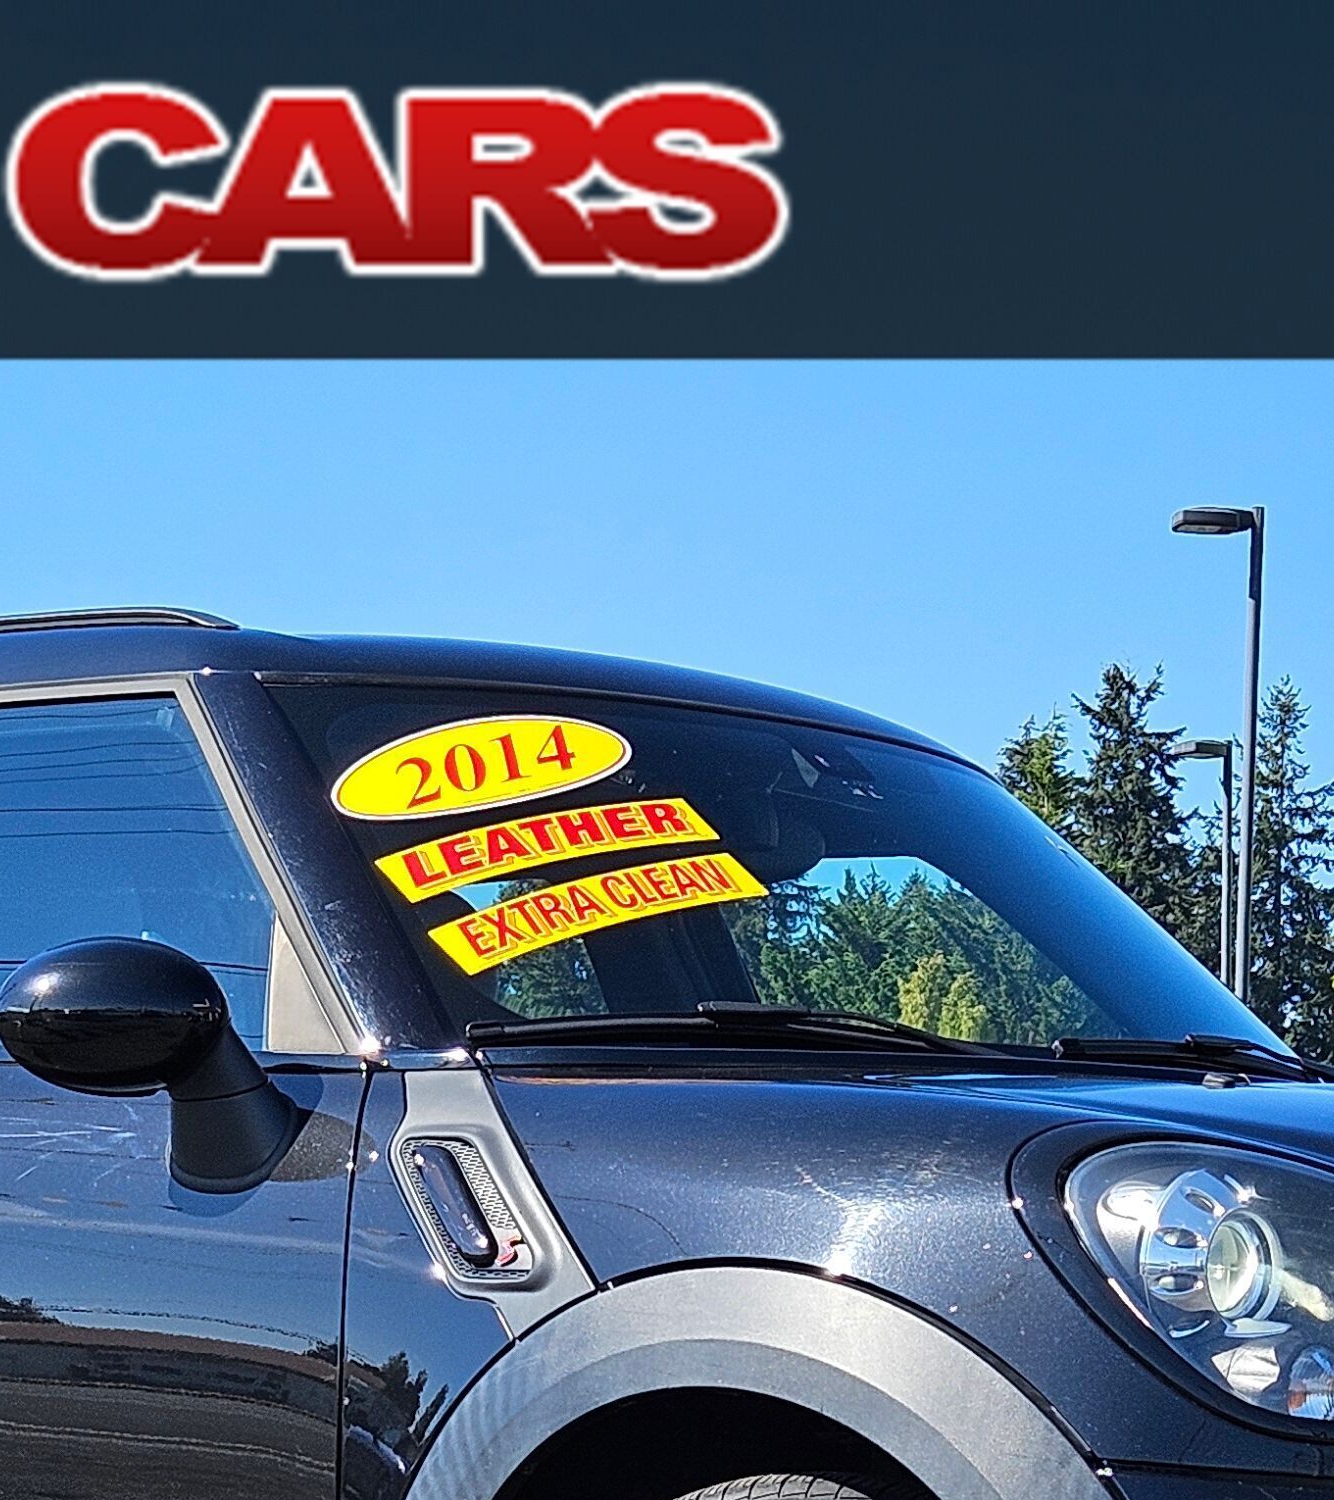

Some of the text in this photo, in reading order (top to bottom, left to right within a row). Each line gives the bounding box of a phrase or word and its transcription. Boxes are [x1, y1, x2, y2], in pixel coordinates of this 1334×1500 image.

[396, 725, 576, 809] 2014
[402, 803, 696, 889] LEATHER
[457, 859, 737, 958] EXTRA CLEAN
